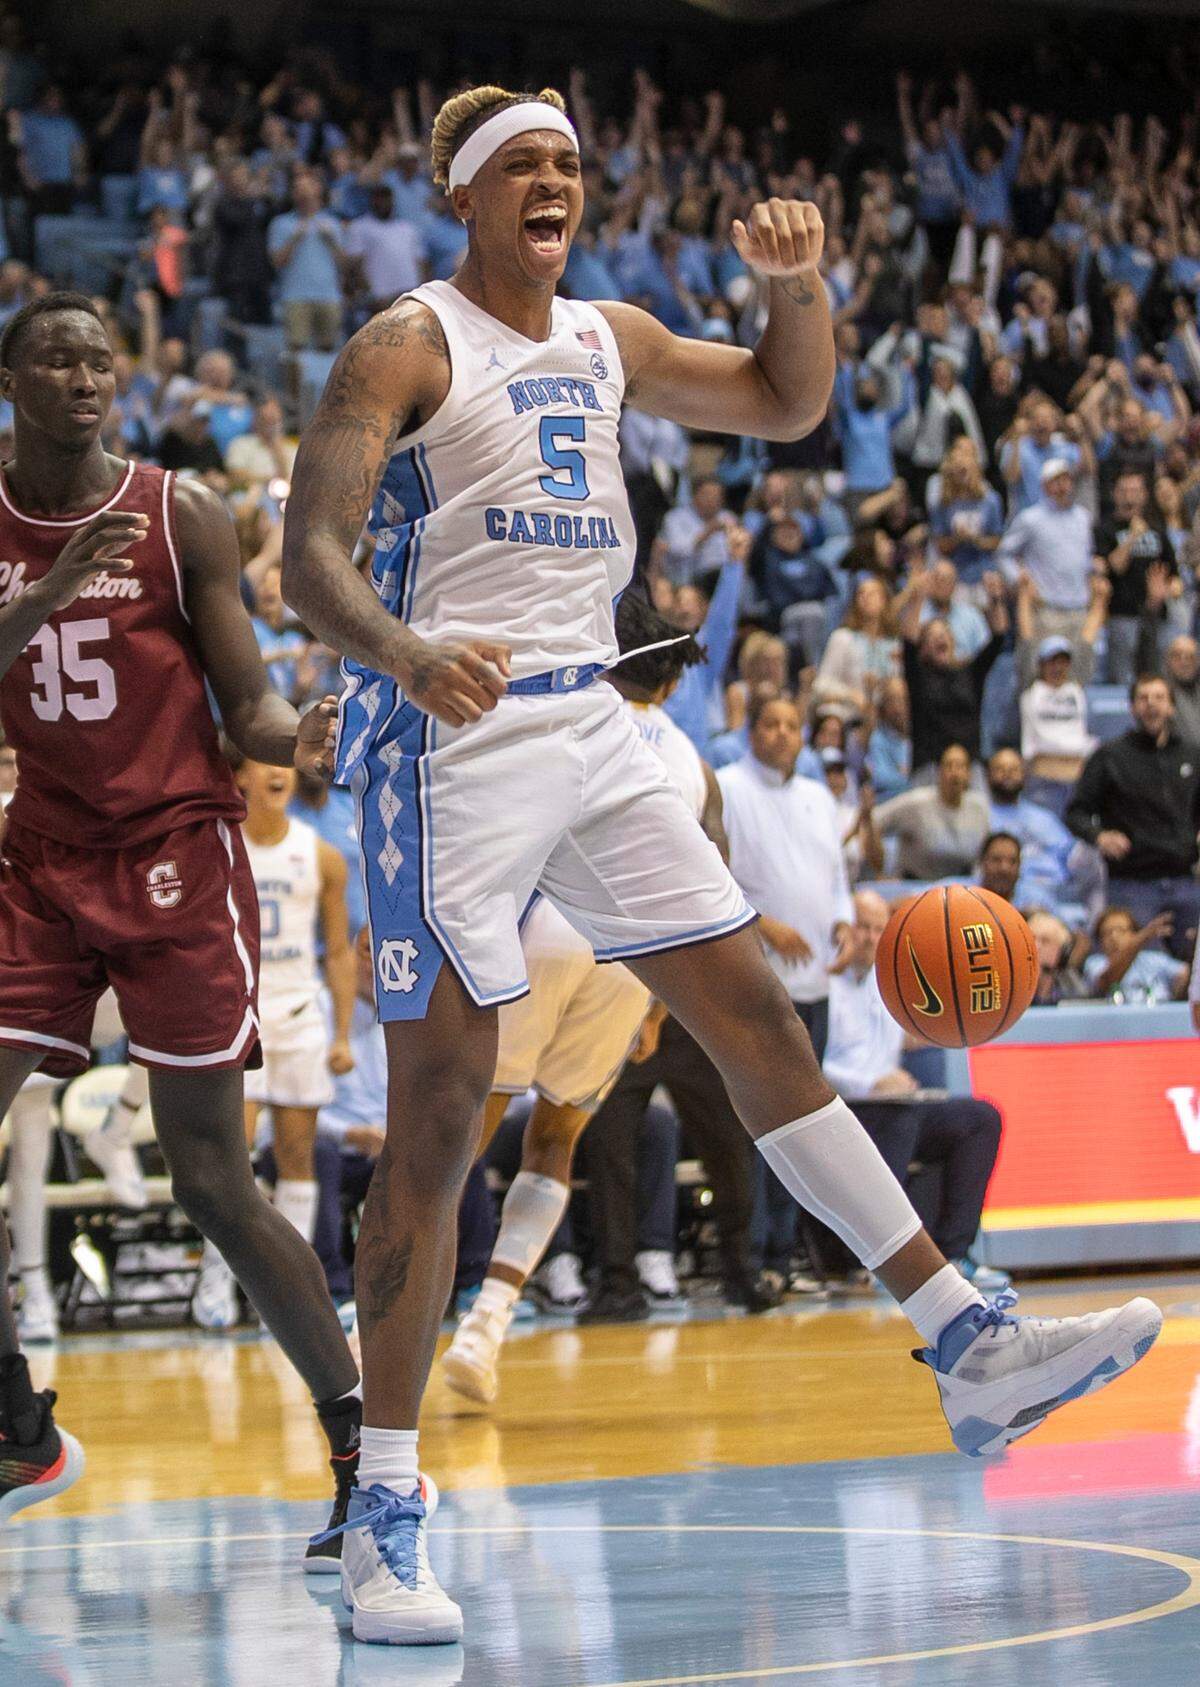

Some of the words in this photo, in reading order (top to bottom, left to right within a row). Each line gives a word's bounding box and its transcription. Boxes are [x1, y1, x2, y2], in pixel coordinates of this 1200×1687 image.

[507, 377, 604, 415] NORTH
[538, 416, 590, 501] 5
[485, 507, 621, 549] CAROLINA
[20, 617, 117, 722] 35
[960, 922, 995, 1015] ELITE
